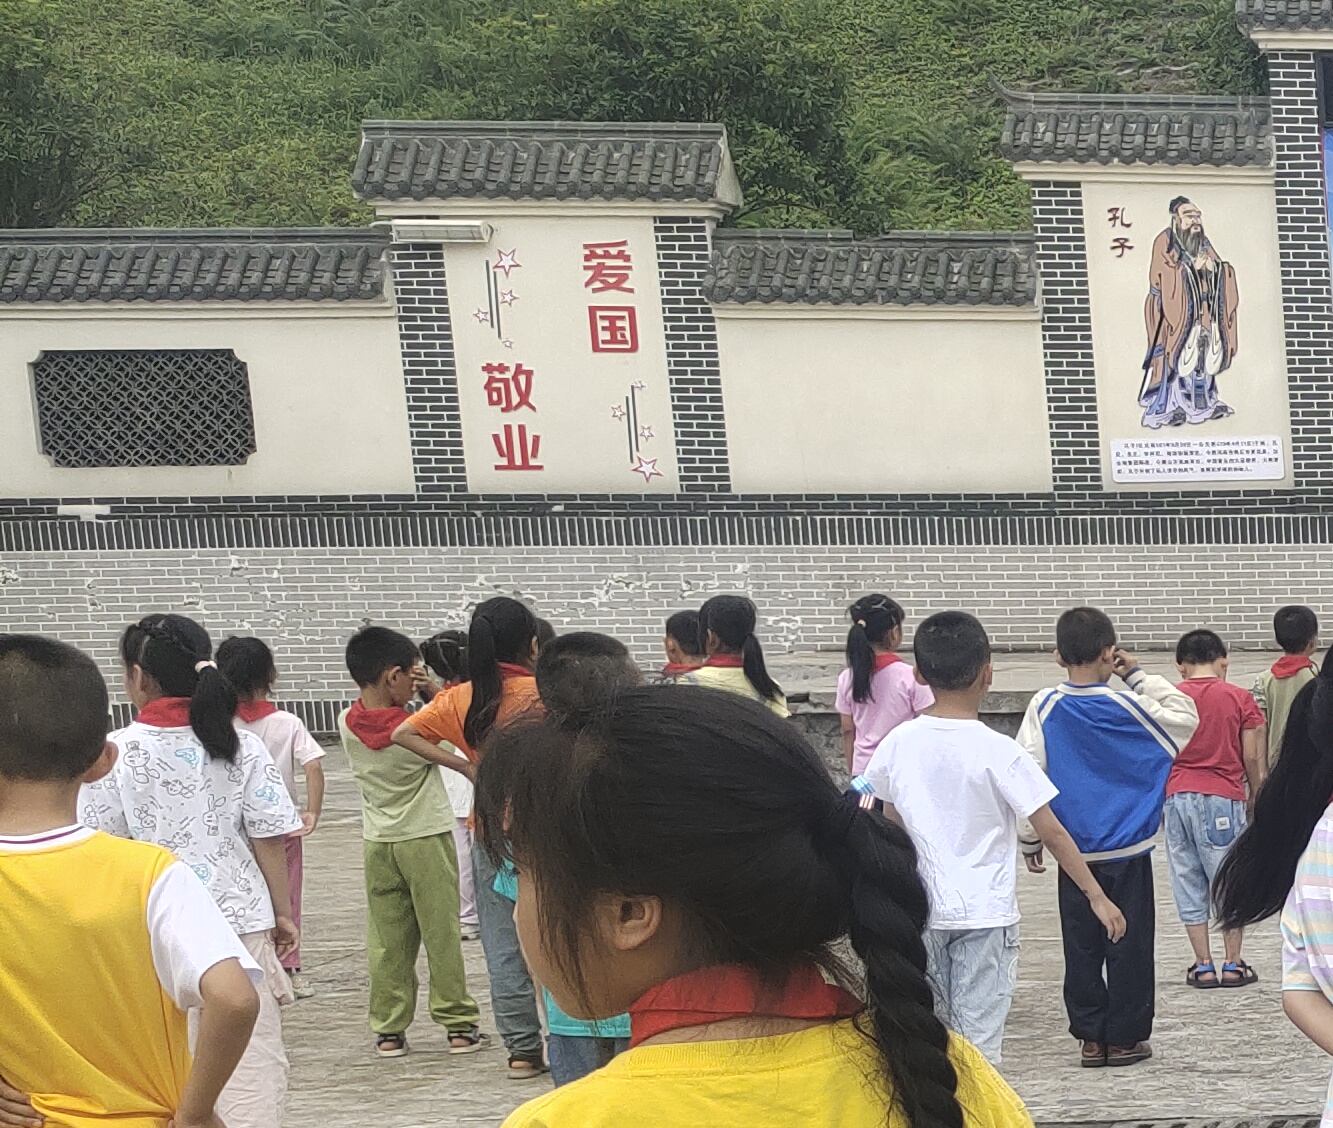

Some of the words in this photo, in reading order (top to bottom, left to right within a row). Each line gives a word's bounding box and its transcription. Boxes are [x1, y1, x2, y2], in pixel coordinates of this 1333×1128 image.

[1107, 207, 1134, 258] 孔子
[583, 240, 639, 354] 爱国
[481, 362, 544, 471] 敬业
